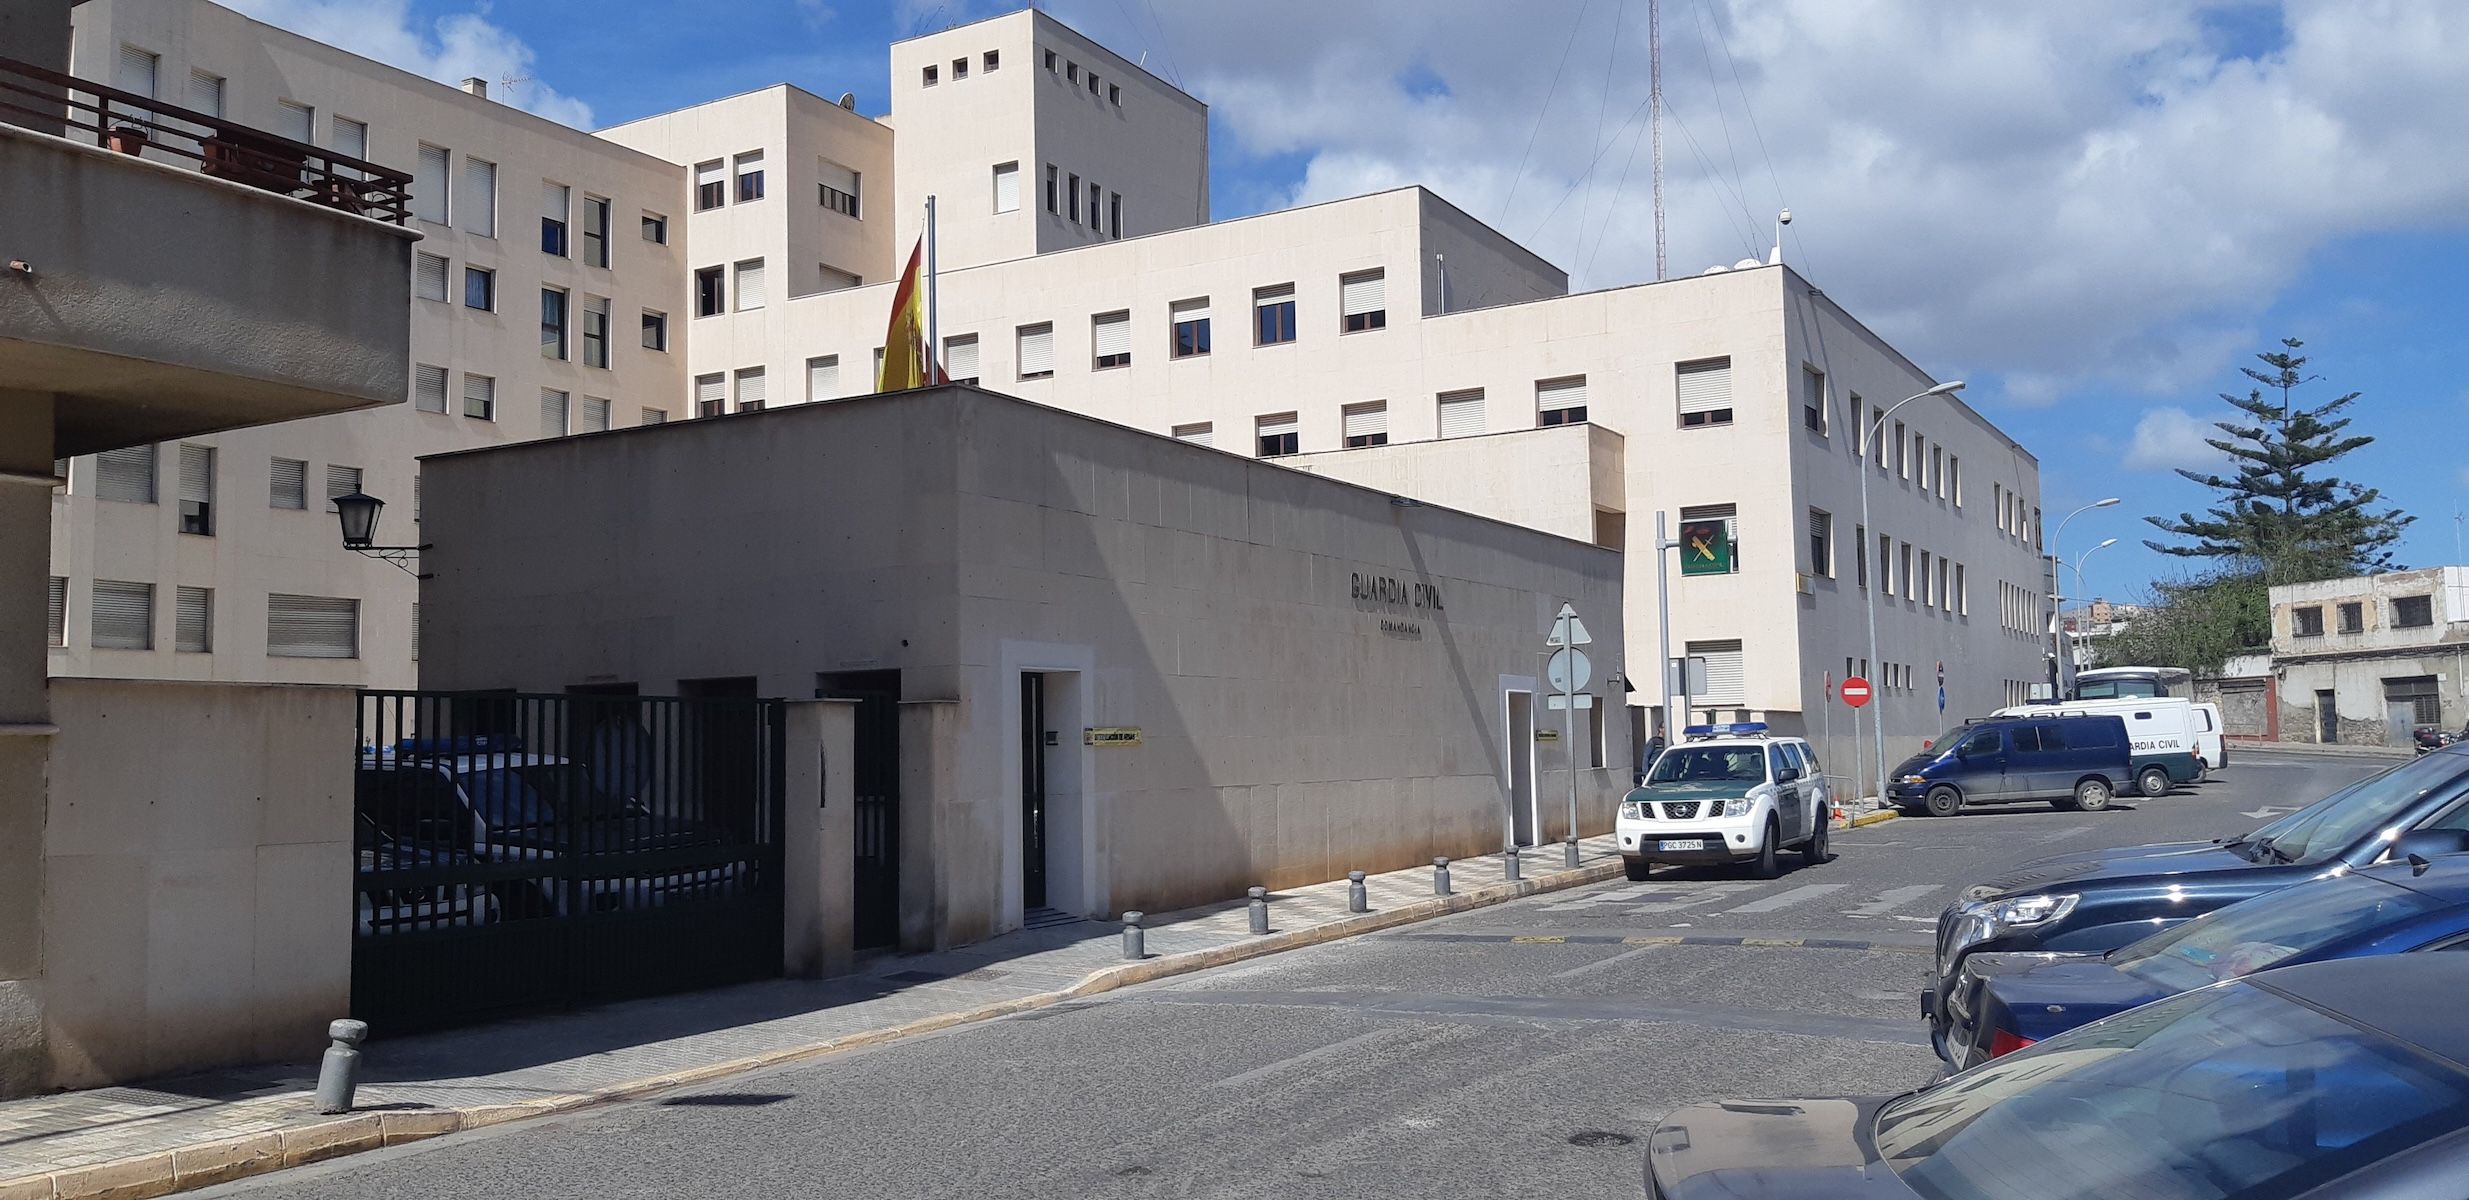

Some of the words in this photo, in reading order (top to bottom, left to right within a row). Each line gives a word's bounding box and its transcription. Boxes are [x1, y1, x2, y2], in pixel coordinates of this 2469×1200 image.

[1351, 572, 1408, 605] GUARDIA
[1414, 582, 1444, 611] CIVIL
[2130, 741, 2156, 751] ARDIA
[2158, 739, 2180, 749] CIVIL
